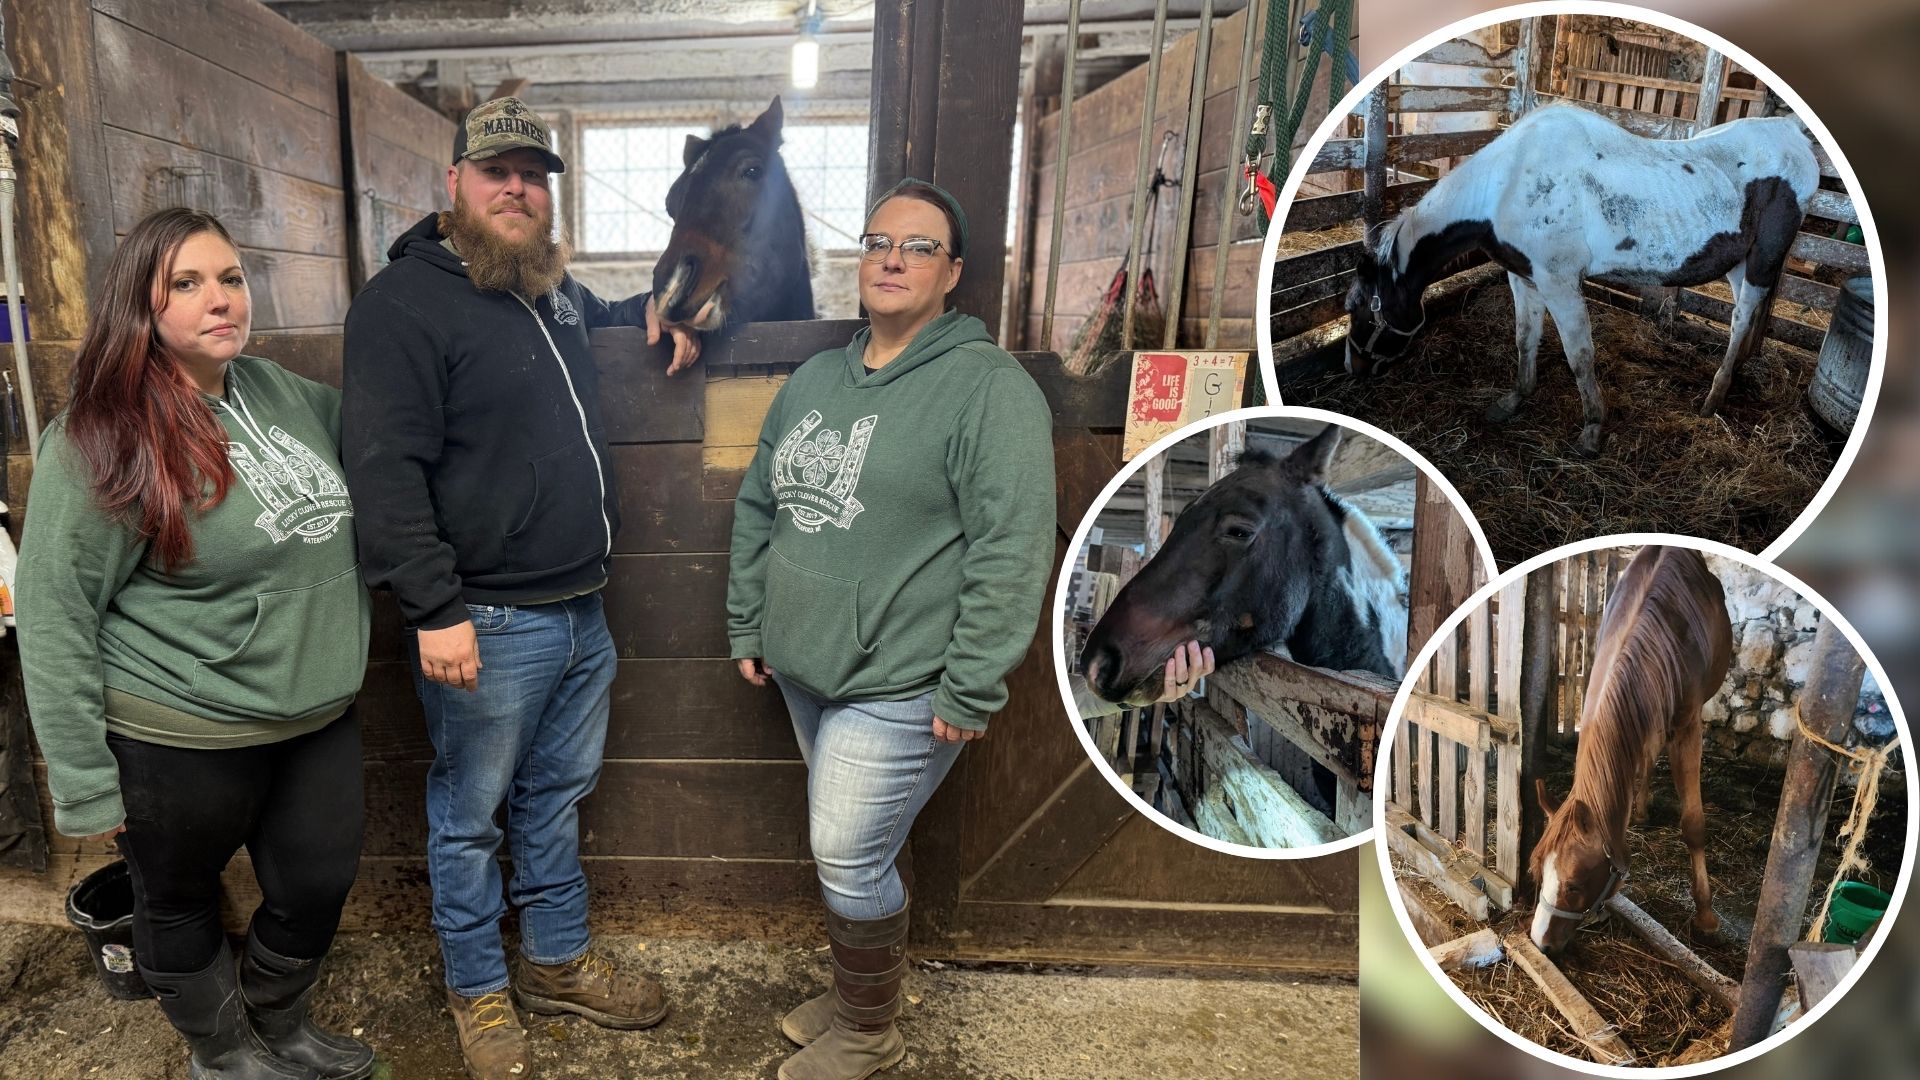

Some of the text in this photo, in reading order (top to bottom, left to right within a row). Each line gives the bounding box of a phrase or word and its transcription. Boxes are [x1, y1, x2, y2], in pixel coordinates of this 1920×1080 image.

[484, 117, 545, 145] MARINES
[1193, 355, 1200, 367] 3
[1211, 355, 1218, 366] 4
[1228, 355, 1234, 366] 7
[1162, 374, 1181, 387] LIFE
[1169, 386, 1179, 398] IS
[1152, 397, 1177, 410] GOOD
[797, 490, 819, 503] CLOVER
[819, 497, 840, 514] RESCUE
[281, 509, 299, 528] LUCKY
[320, 499, 347, 508] RESCUE
